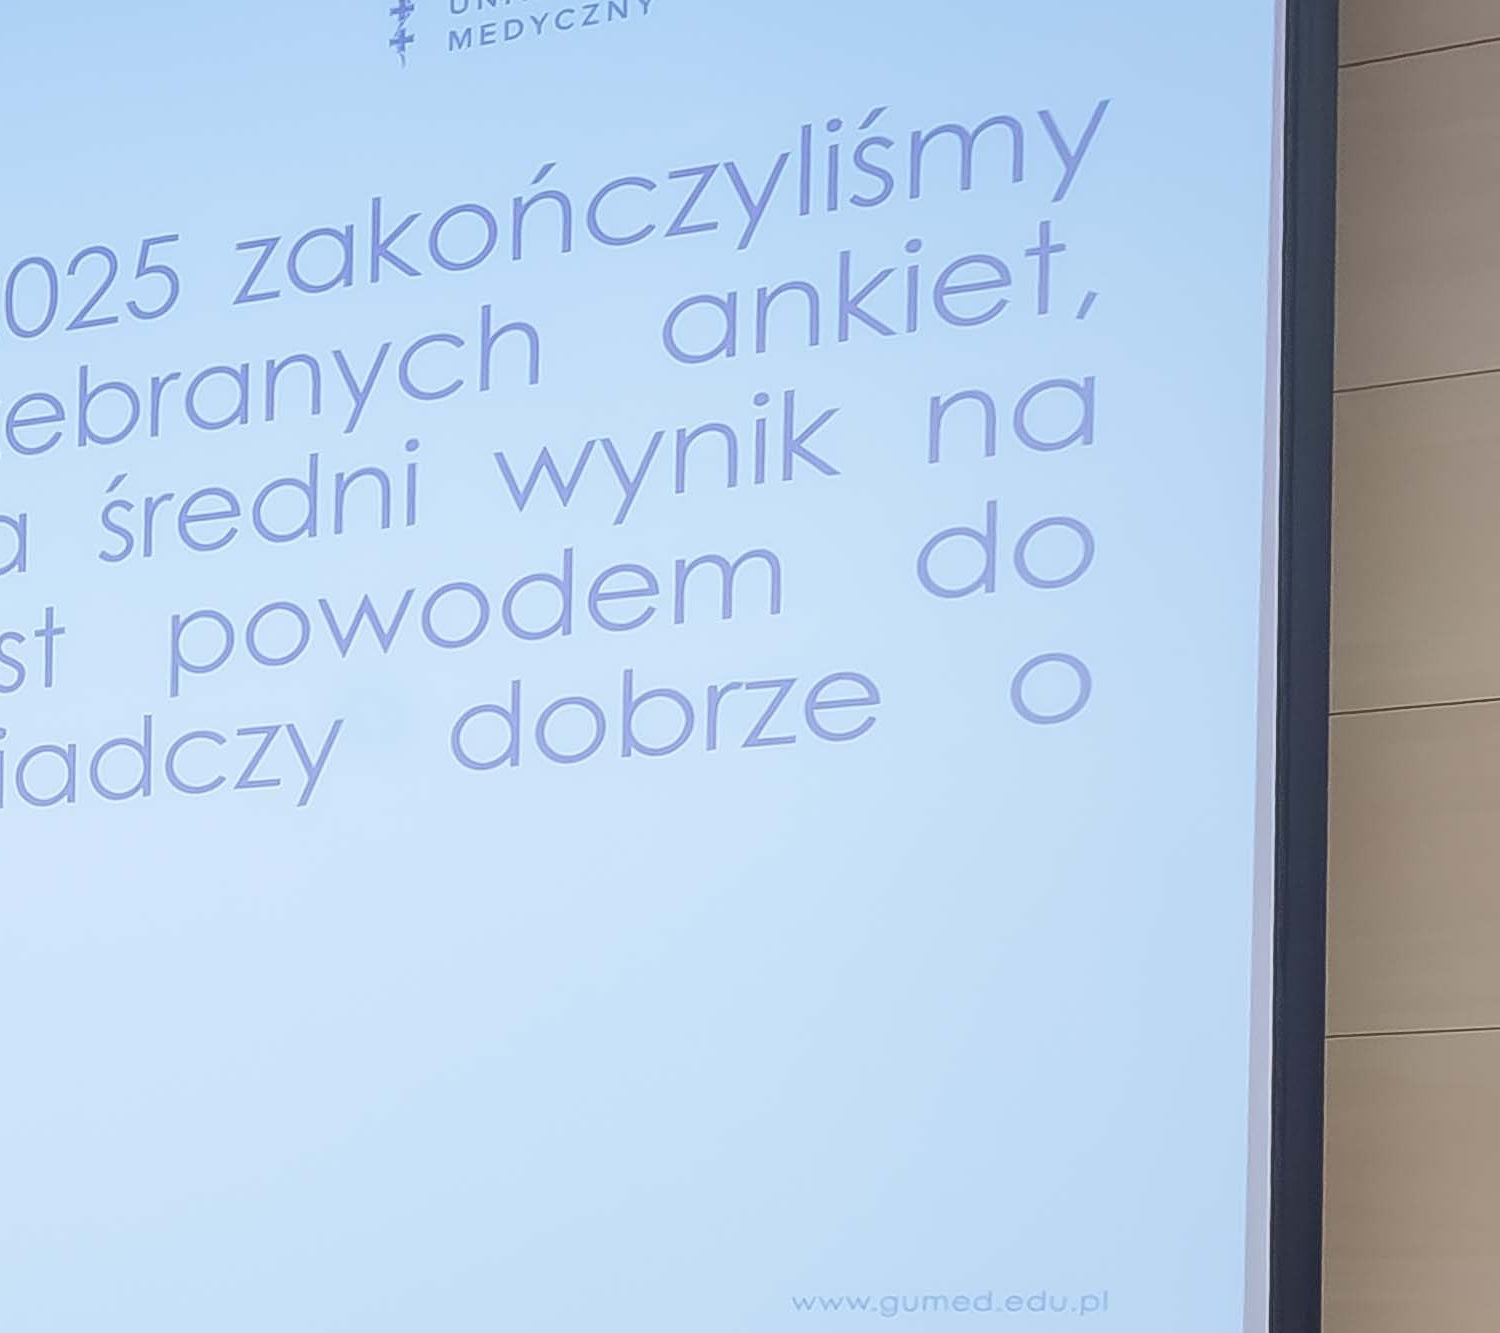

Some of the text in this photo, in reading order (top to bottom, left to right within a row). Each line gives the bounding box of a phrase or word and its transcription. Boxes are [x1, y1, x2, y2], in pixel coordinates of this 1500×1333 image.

[232, 98, 1111, 306] zakończyliśmy
[661, 219, 1098, 365] ankiet,
[98, 437, 420, 564] średni
[493, 388, 841, 527] wynik
[927, 375, 1096, 465] na
[169, 546, 782, 699] powodem
[916, 499, 1096, 600] do
[450, 667, 882, 772] dobrze
[1010, 652, 1093, 726] o
[791, 1291, 1109, 1318] www.gumed.edu.pl
